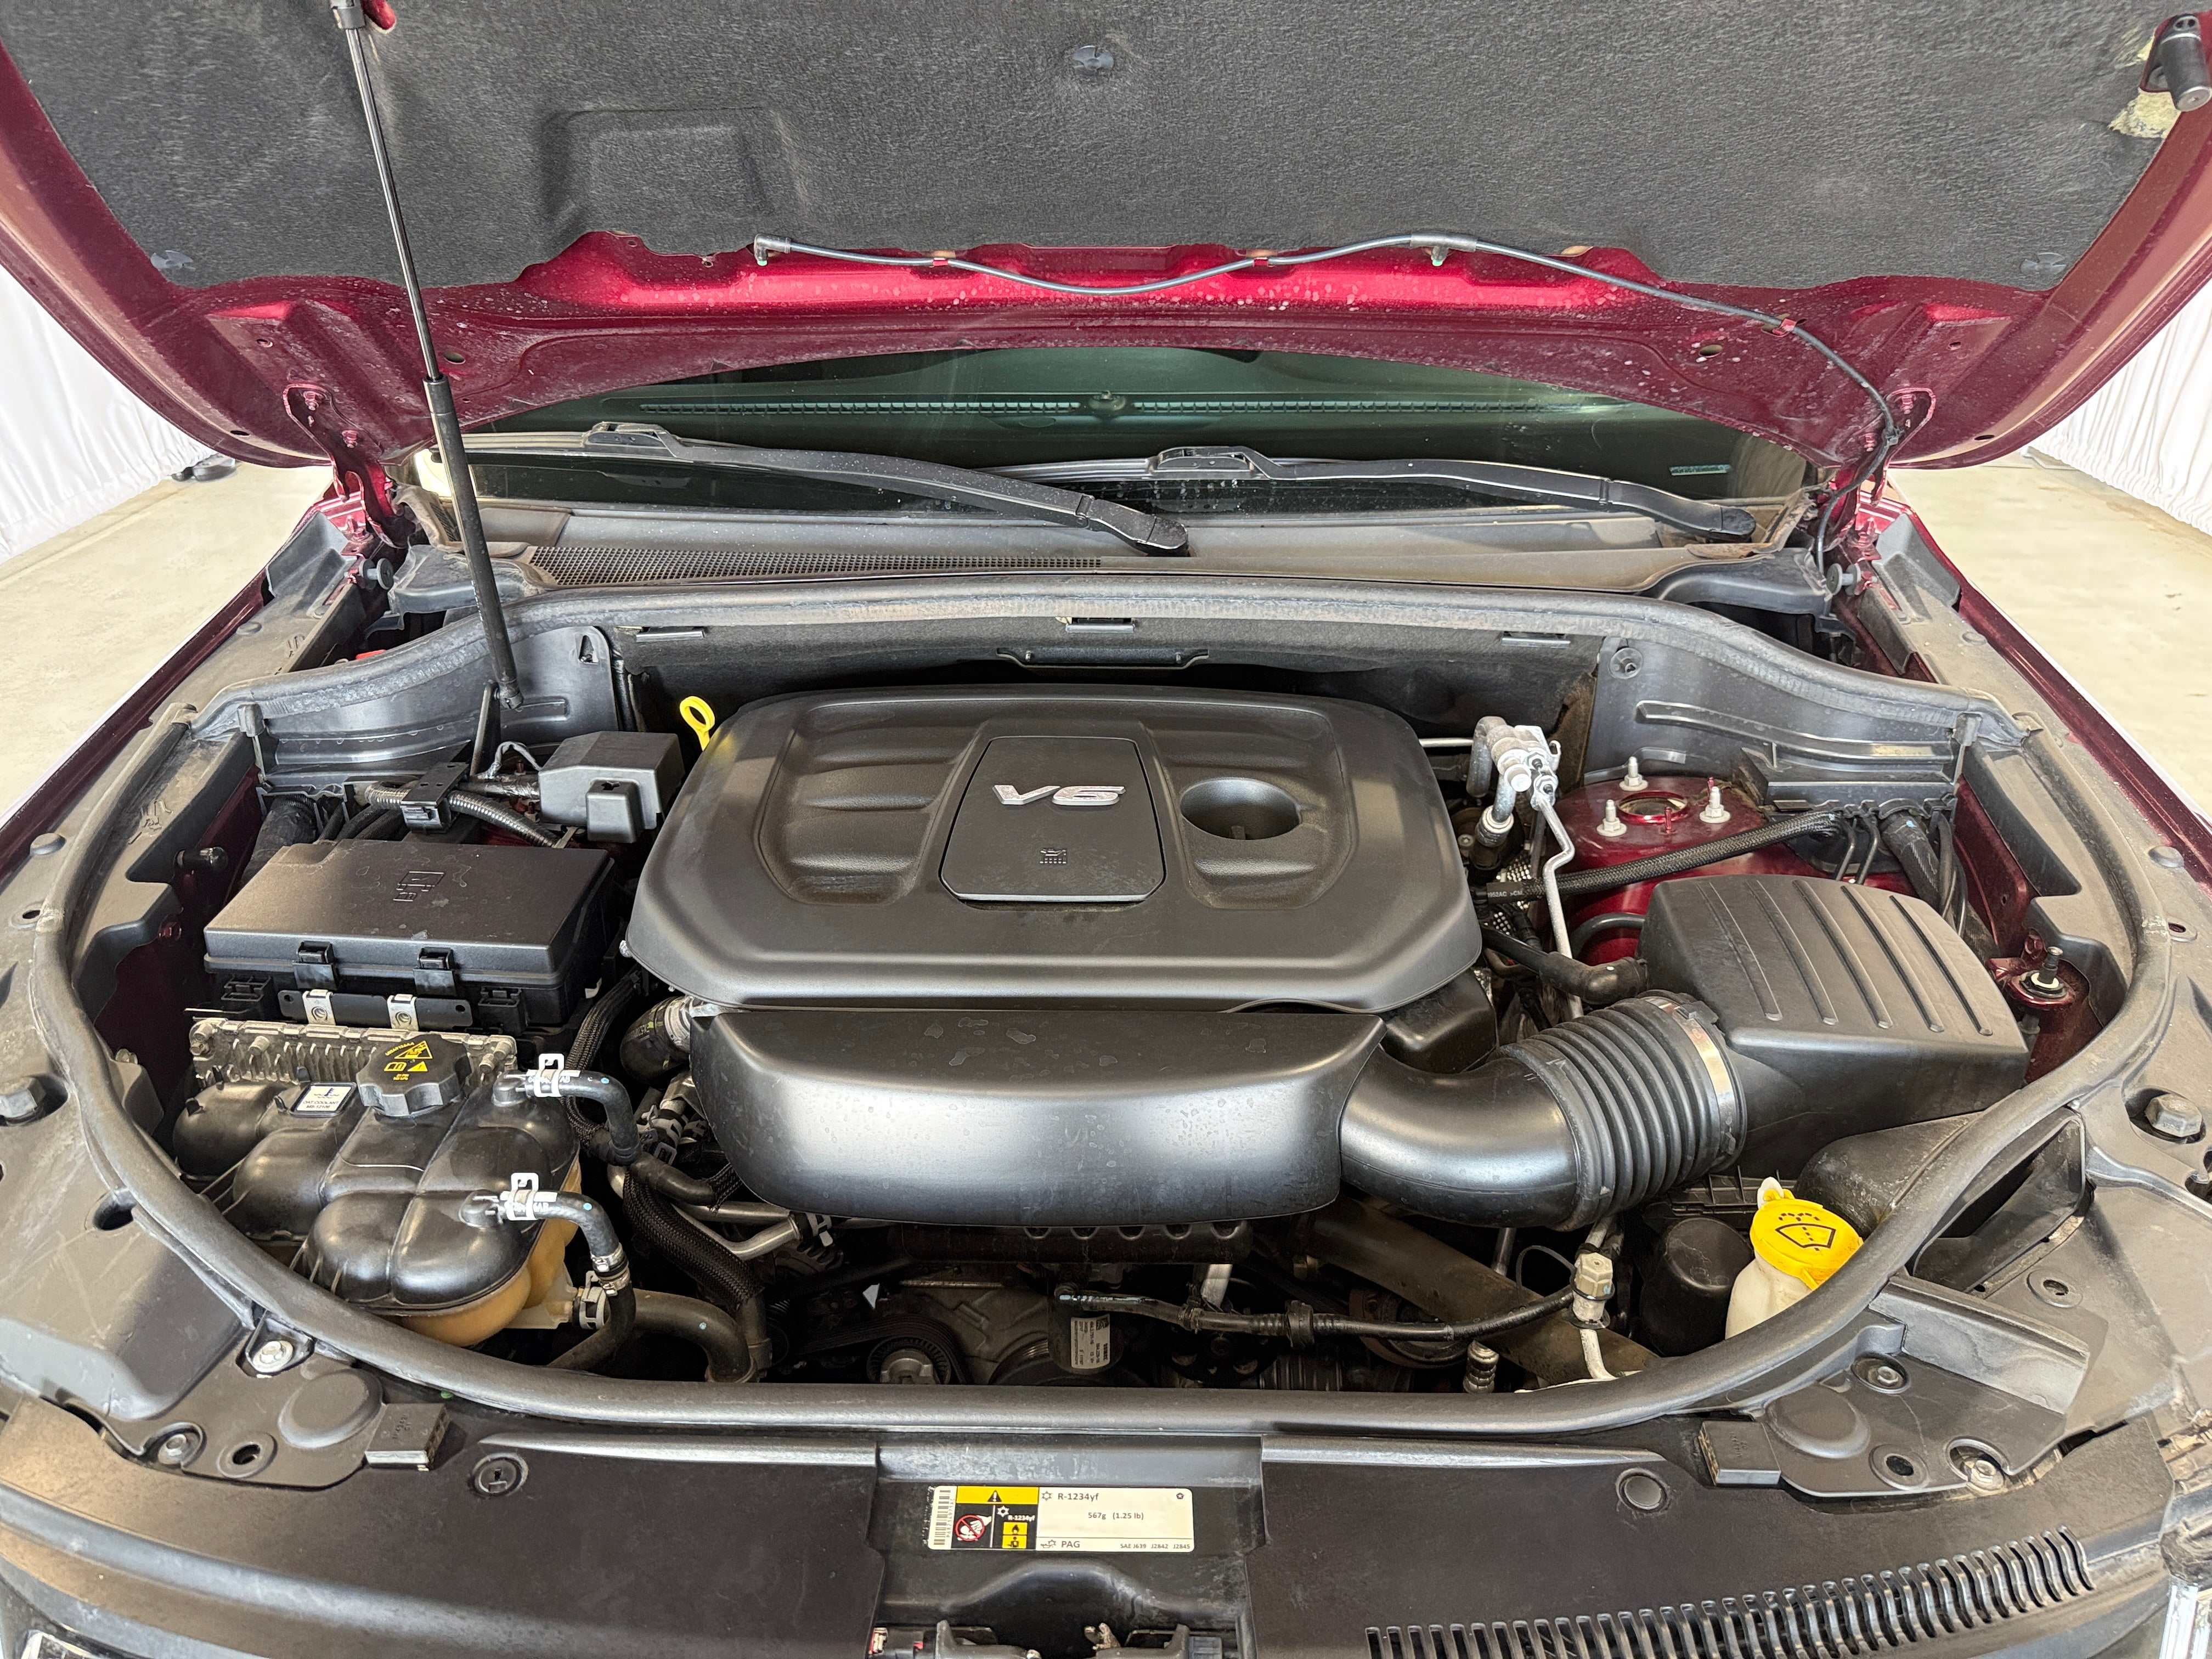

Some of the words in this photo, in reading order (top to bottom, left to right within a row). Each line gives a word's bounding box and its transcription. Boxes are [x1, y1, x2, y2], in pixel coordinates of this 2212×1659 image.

[992, 785, 1126, 806] V6
[1057, 1492, 1099, 1502] R-1234yf
[1087, 1511, 1107, 1520] 567g
[1113, 1511, 1132, 1520] (1.25
[1133, 1511, 1144, 1520] lb)
